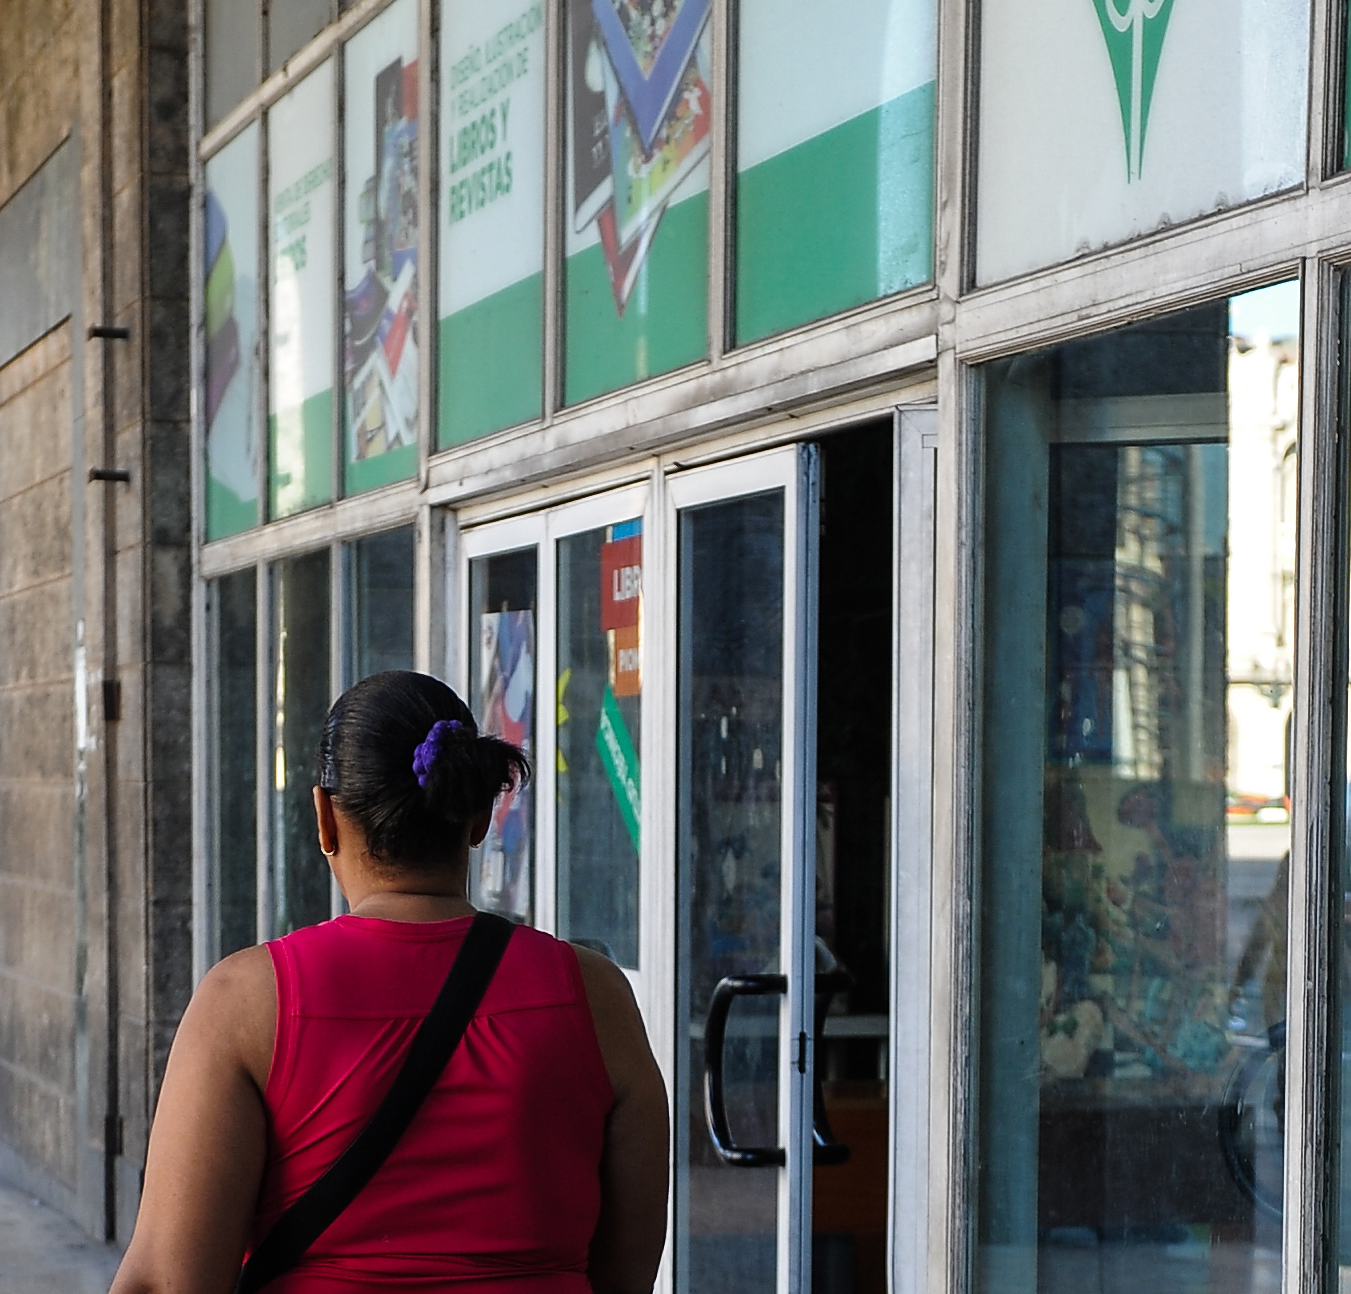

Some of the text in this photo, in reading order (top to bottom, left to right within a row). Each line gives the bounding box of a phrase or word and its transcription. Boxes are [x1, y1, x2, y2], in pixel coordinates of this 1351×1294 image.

[449, 98, 510, 174] LIBROS Y
[449, 151, 513, 225] REVISTAS
